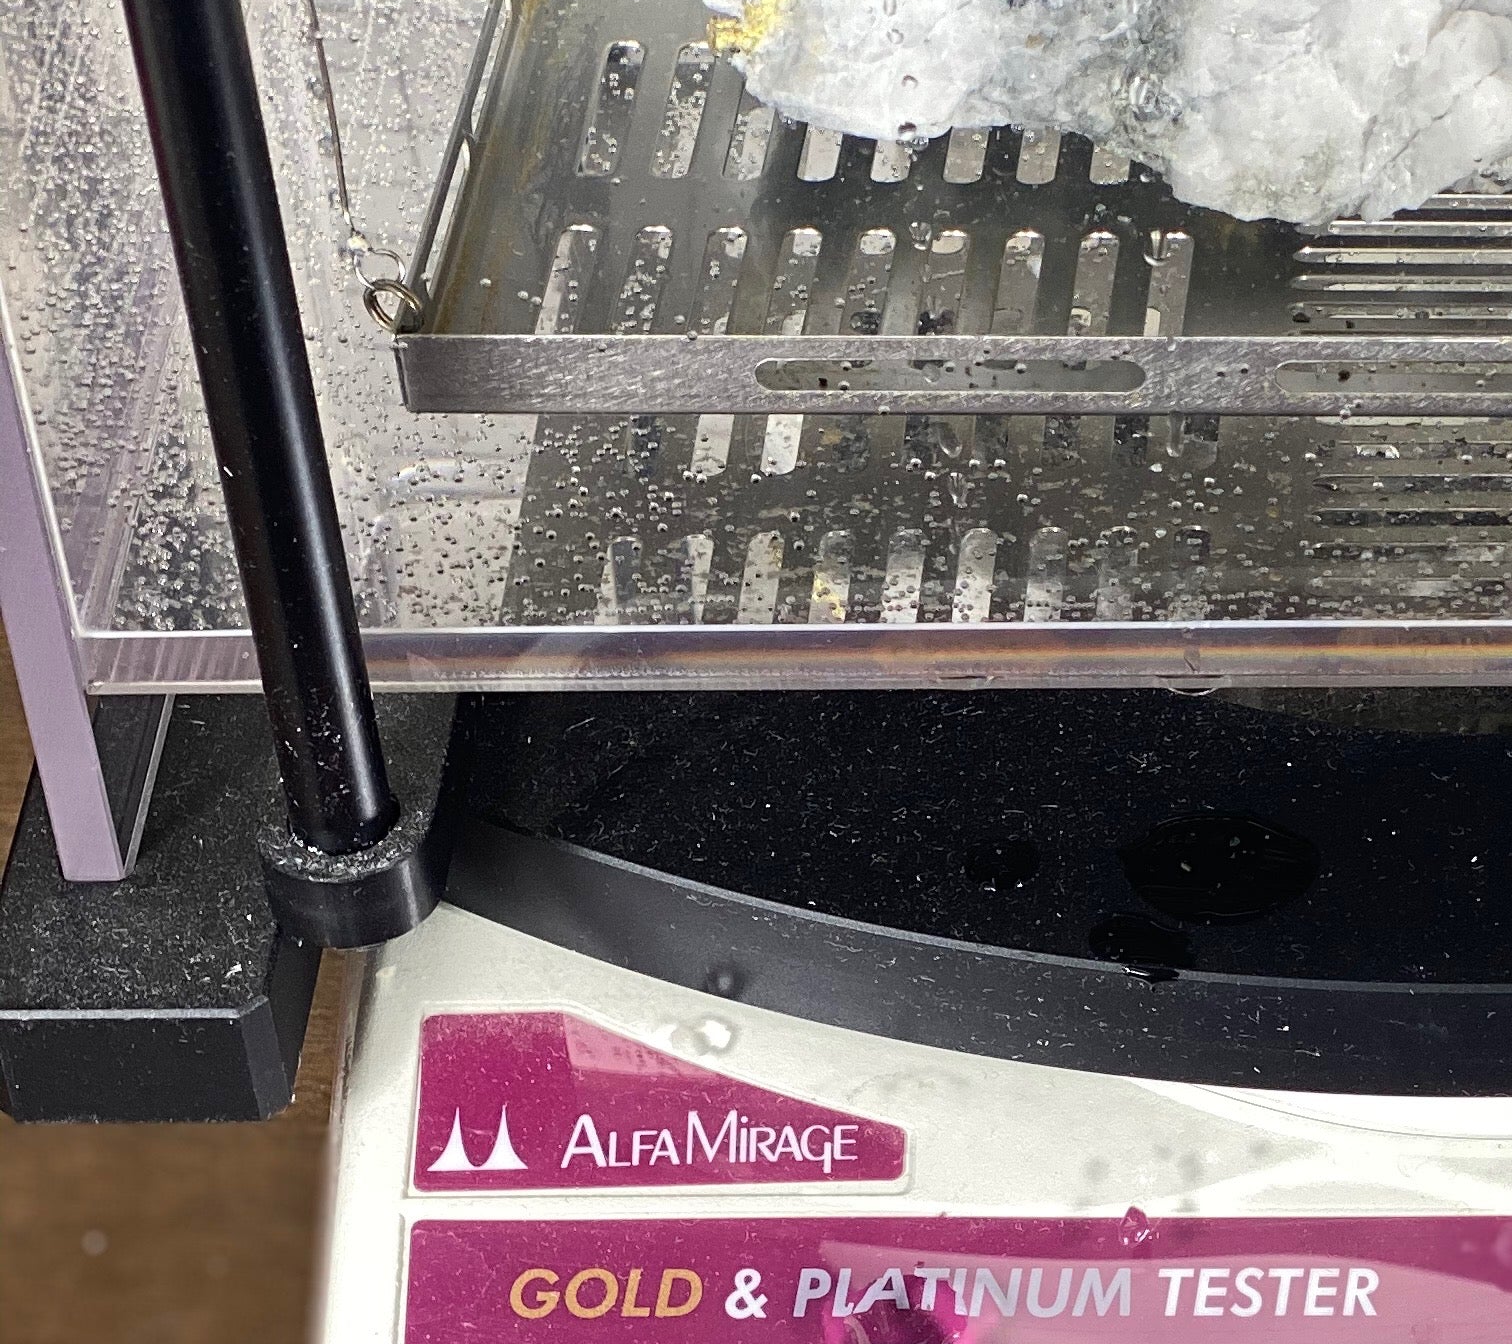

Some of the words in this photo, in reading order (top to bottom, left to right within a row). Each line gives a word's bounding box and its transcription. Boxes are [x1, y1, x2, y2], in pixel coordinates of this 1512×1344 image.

[509, 1267, 704, 1320] GOLD
[724, 1268, 768, 1319] &
[793, 1267, 1132, 1318] PLATINUM
[1158, 1266, 1380, 1318] TESTER
